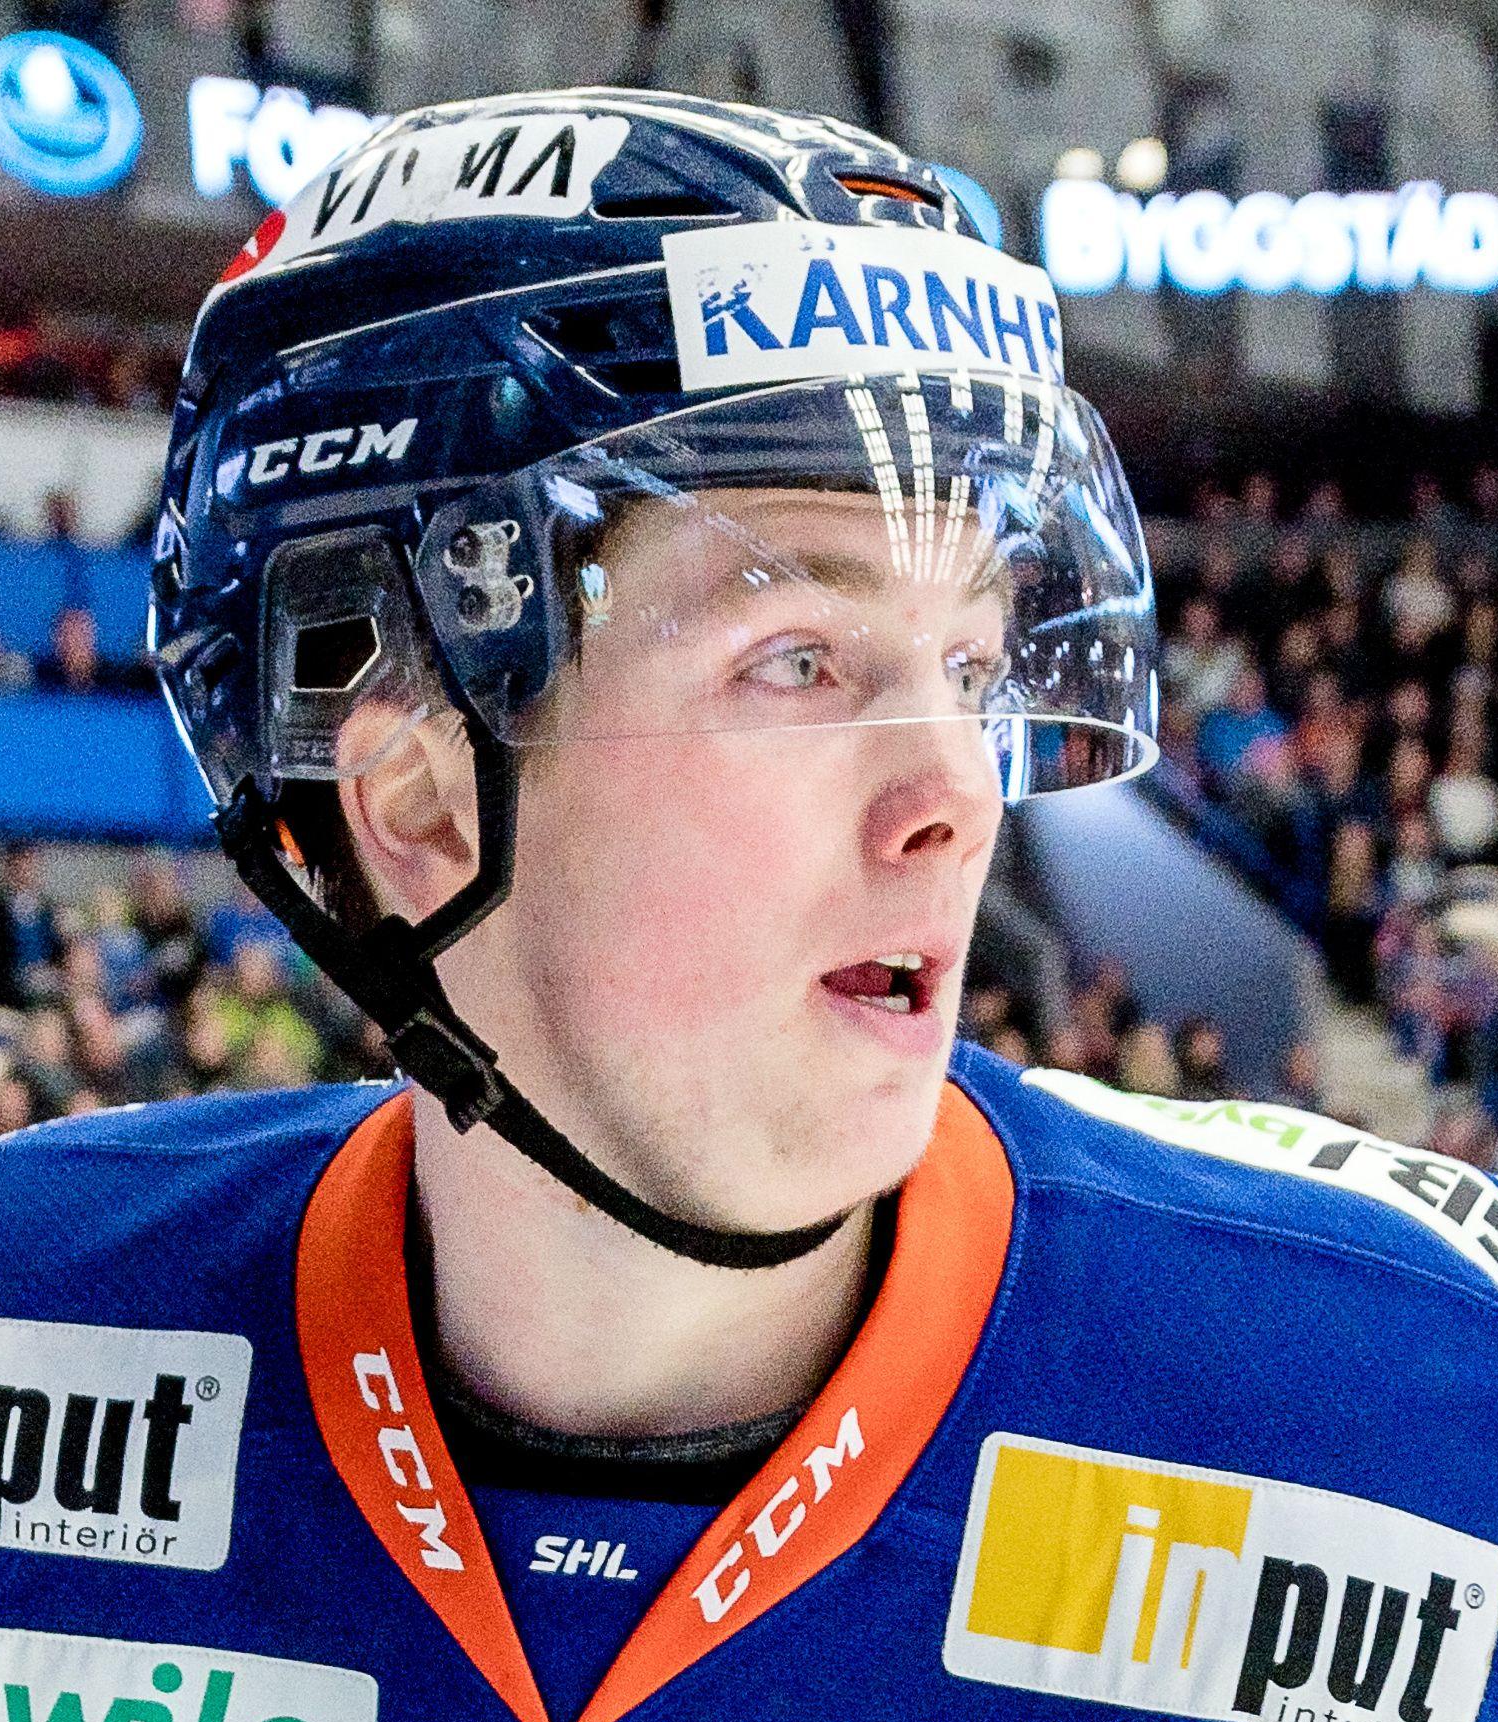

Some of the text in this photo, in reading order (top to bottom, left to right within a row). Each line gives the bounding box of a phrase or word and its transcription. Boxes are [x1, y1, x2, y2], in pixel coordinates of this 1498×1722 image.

[248, 418, 419, 486] CCM
[353, 1347, 465, 1572] CCM
[13, 1512, 178, 1560] interiör
[692, 1406, 866, 1624] CCM
[529, 1535, 639, 1580] SHL
